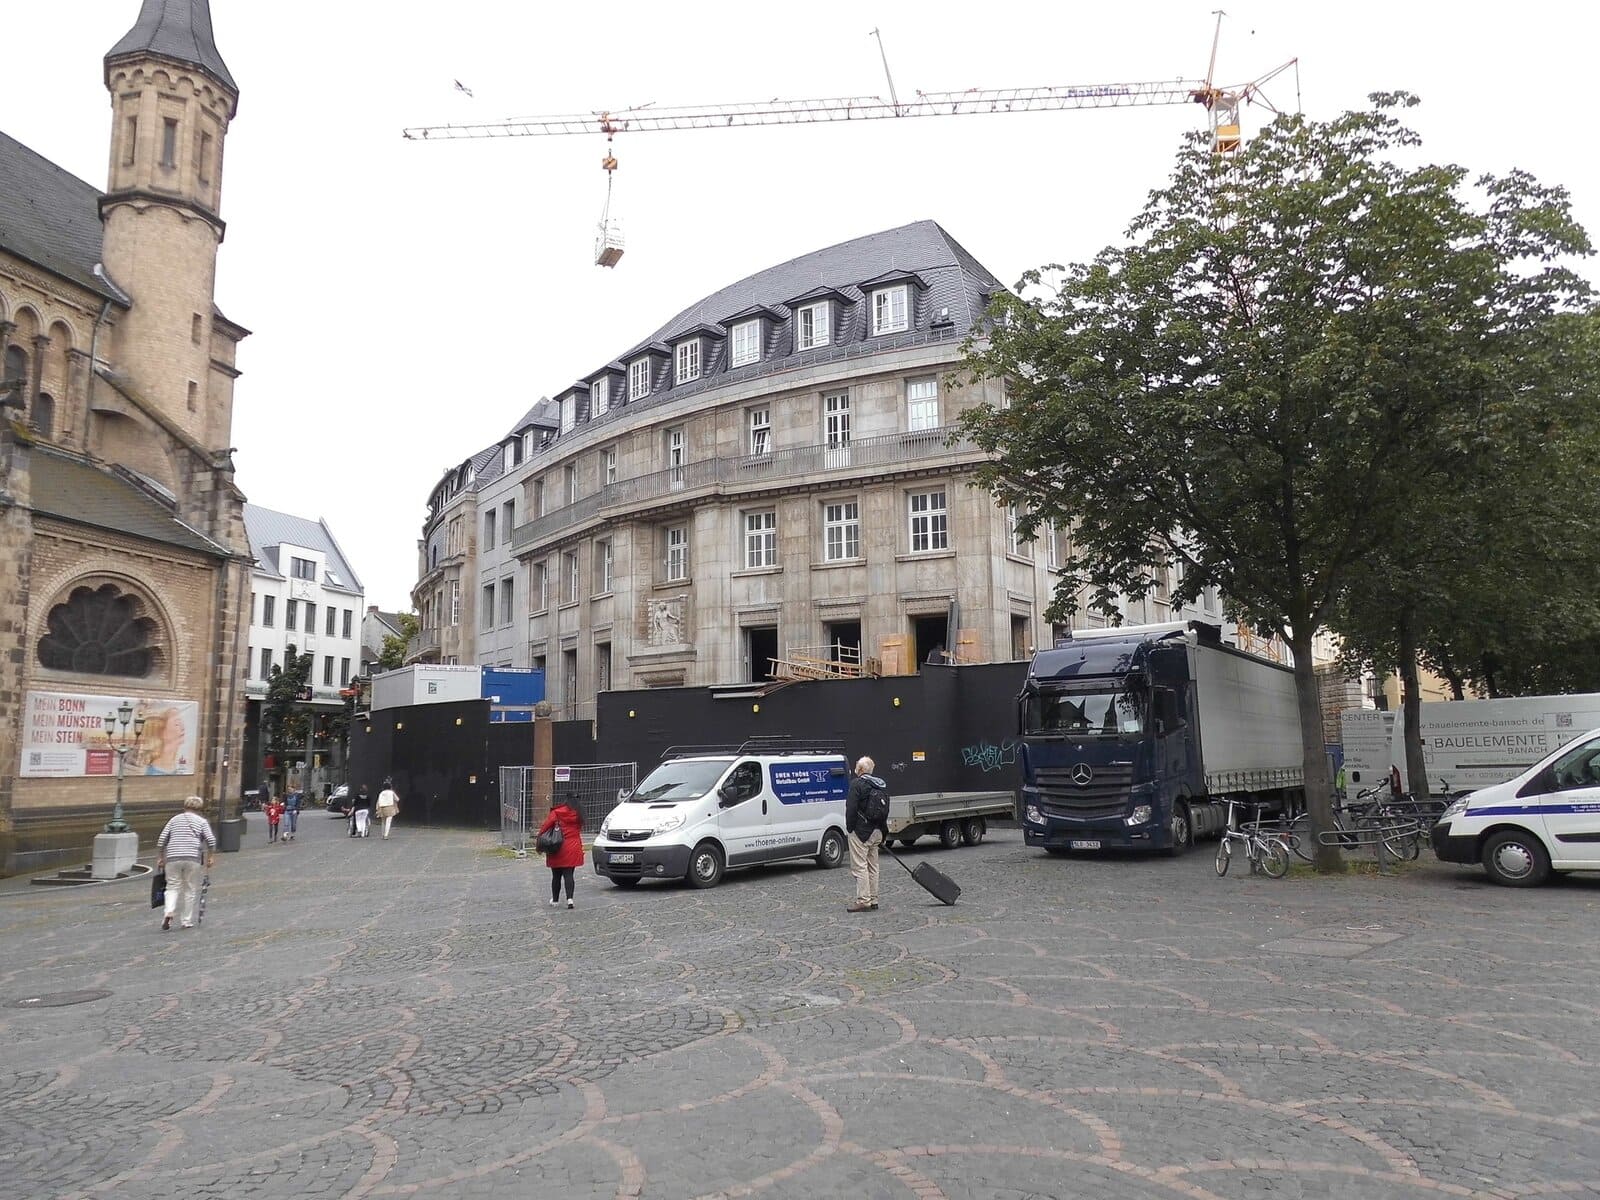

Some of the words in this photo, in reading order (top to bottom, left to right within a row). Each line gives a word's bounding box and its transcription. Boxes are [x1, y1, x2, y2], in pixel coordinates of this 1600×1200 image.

[34, 698, 56, 710] MEIN
[59, 698, 85, 712] BONN
[33, 714, 55, 727] MEIN
[57, 712, 101, 728] MÜNSTER
[32, 730, 54, 743] MEIN
[56, 731, 83, 743] STEIN
[1435, 734, 1547, 748] BAUELEMENTE
